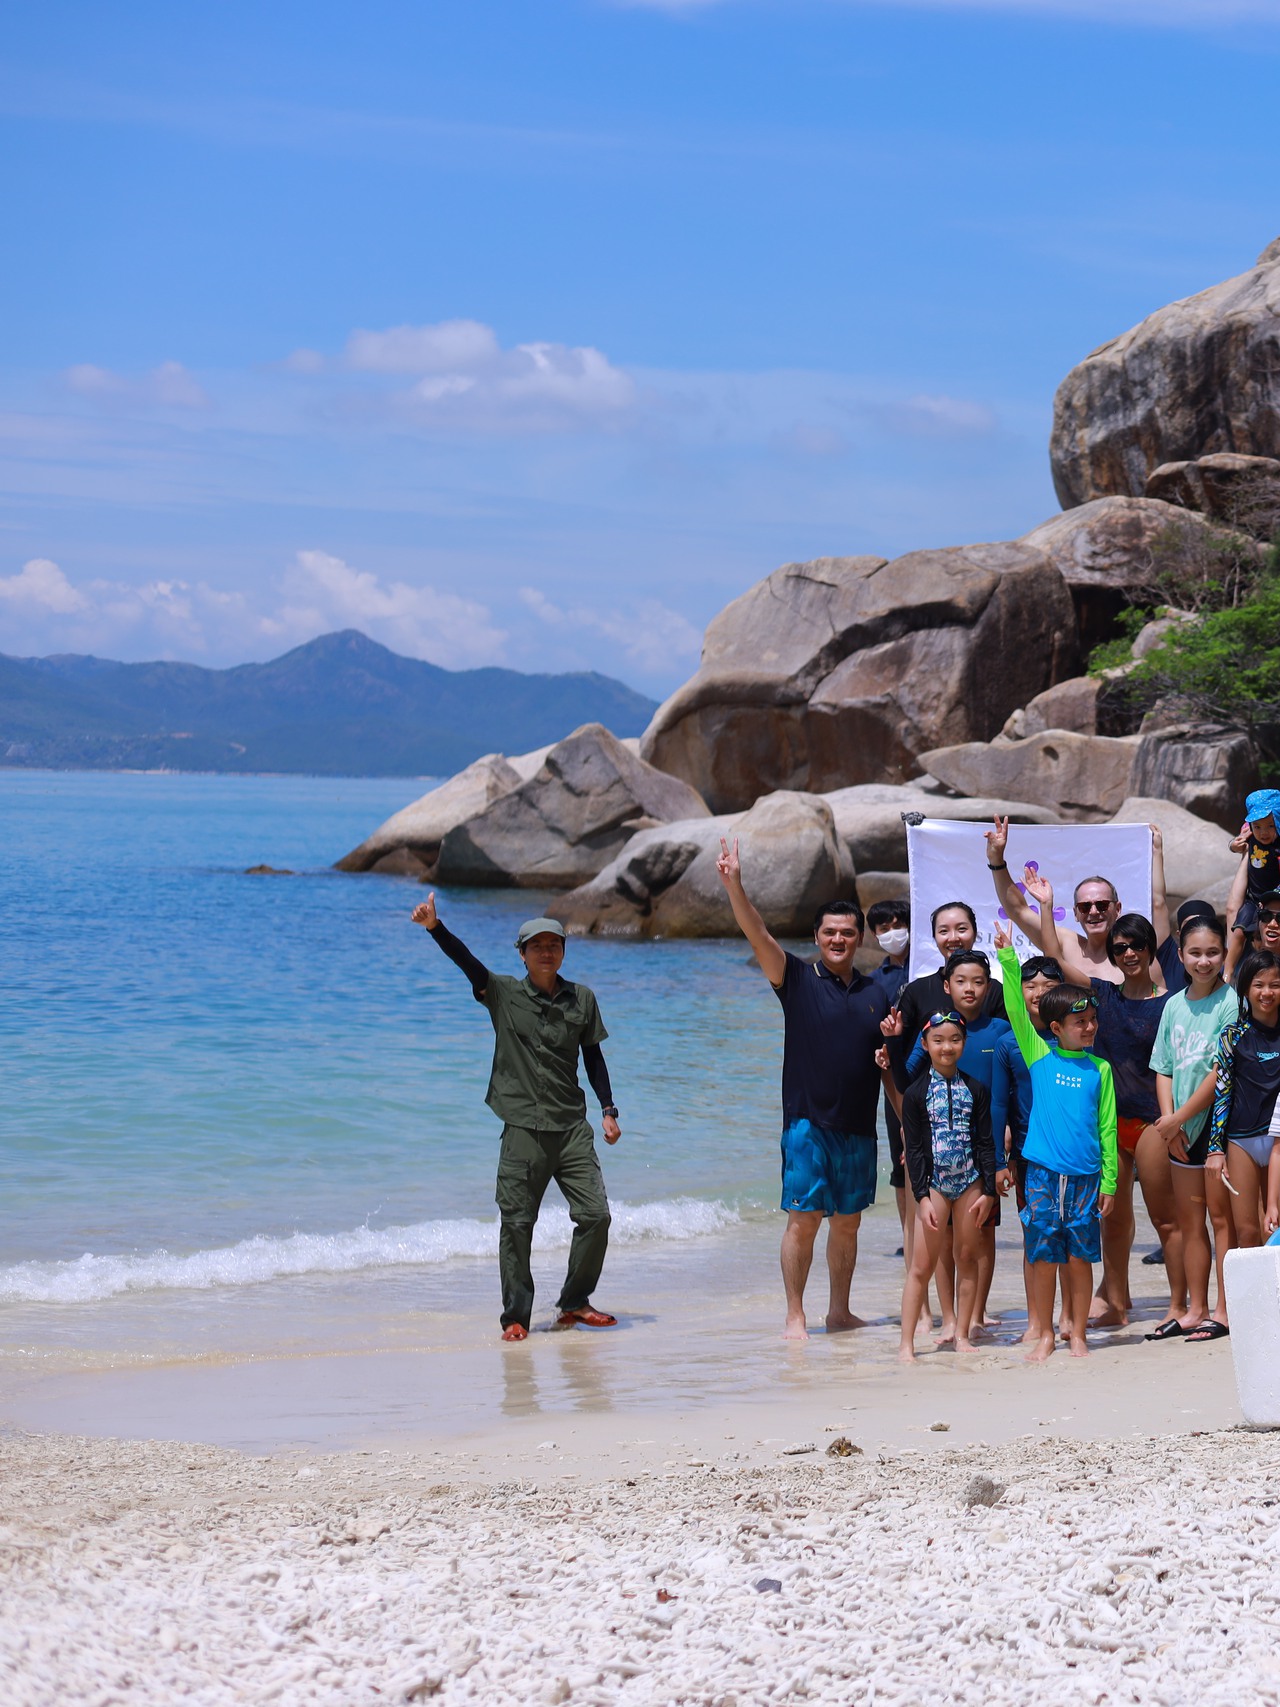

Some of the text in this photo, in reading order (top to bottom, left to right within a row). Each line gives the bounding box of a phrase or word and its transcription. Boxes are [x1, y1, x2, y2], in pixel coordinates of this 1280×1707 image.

[1171, 1024, 1216, 1060] Phillies
[1056, 1072, 1082, 1082] BEACH
[1055, 1079, 1081, 1088] BREAK
